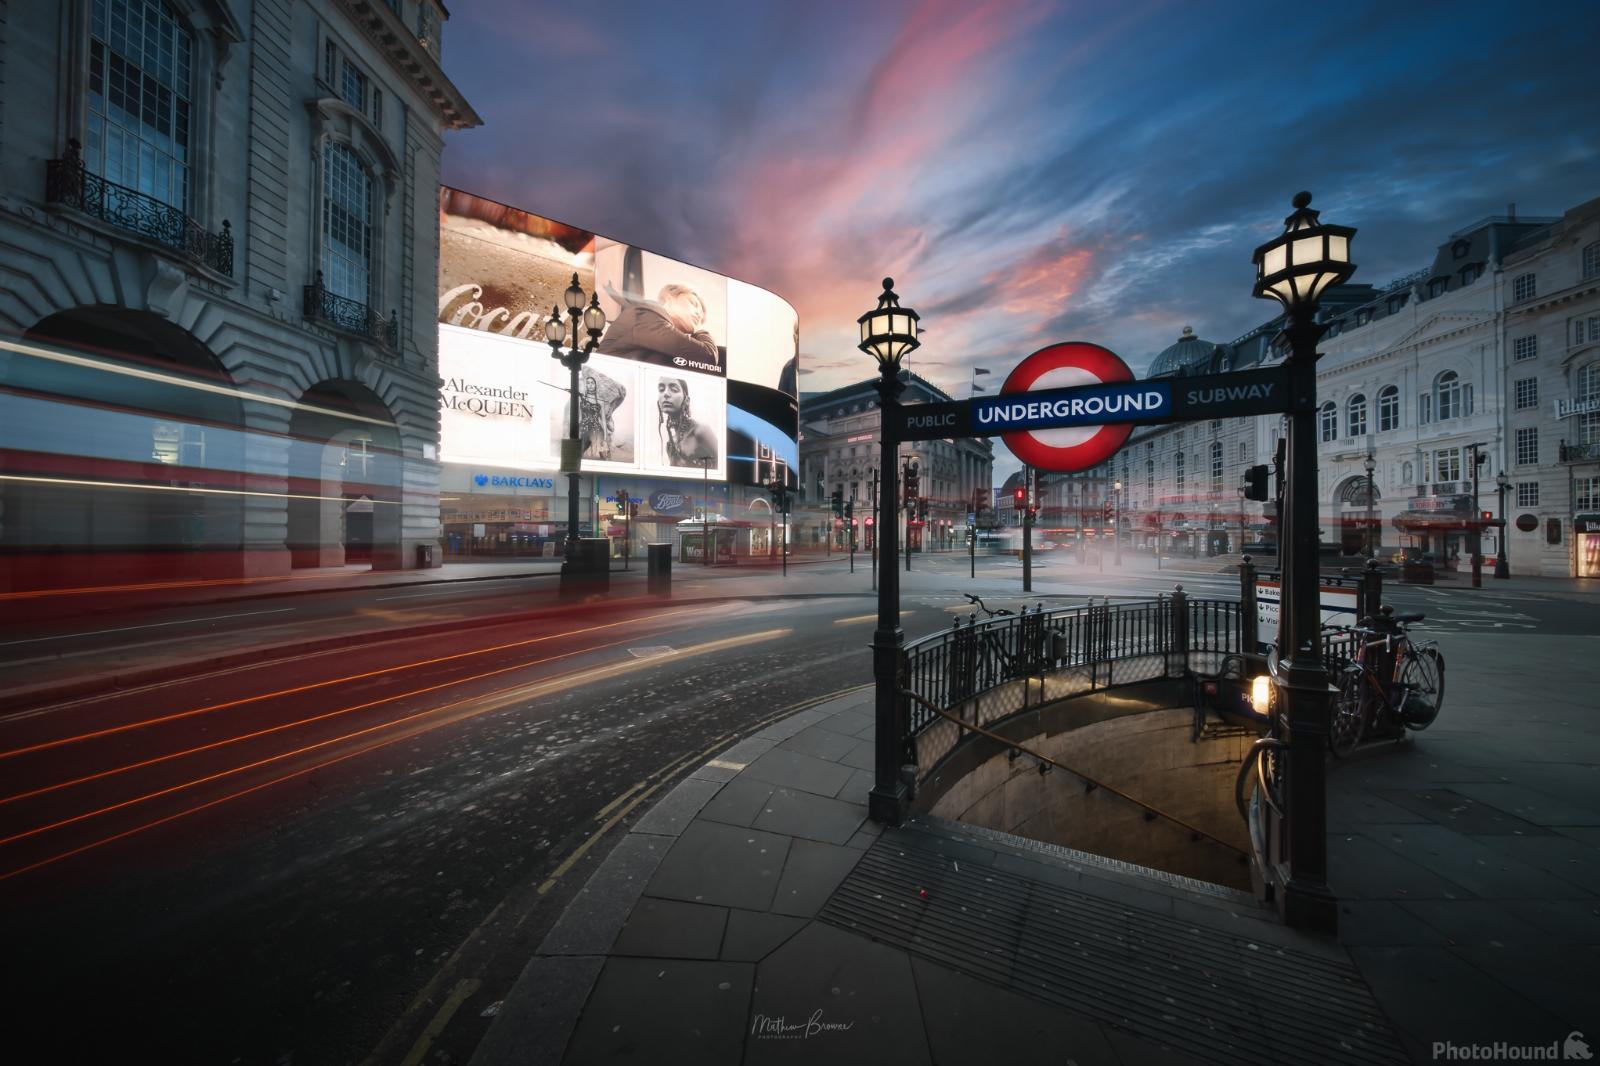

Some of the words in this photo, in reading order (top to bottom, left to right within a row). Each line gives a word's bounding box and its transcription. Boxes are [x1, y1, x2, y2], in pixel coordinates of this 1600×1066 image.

[688, 360, 722, 373] HYUNDAI
[444, 377, 529, 401] Alexander
[1187, 382, 1275, 406] SUBWAY
[440, 394, 534, 419] McQUEEN
[978, 391, 1163, 424] UNDERGROUND
[907, 413, 957, 429] PUBLIC
[491, 475, 554, 489] BARCLAYS
[654, 493, 686, 510] Boots
